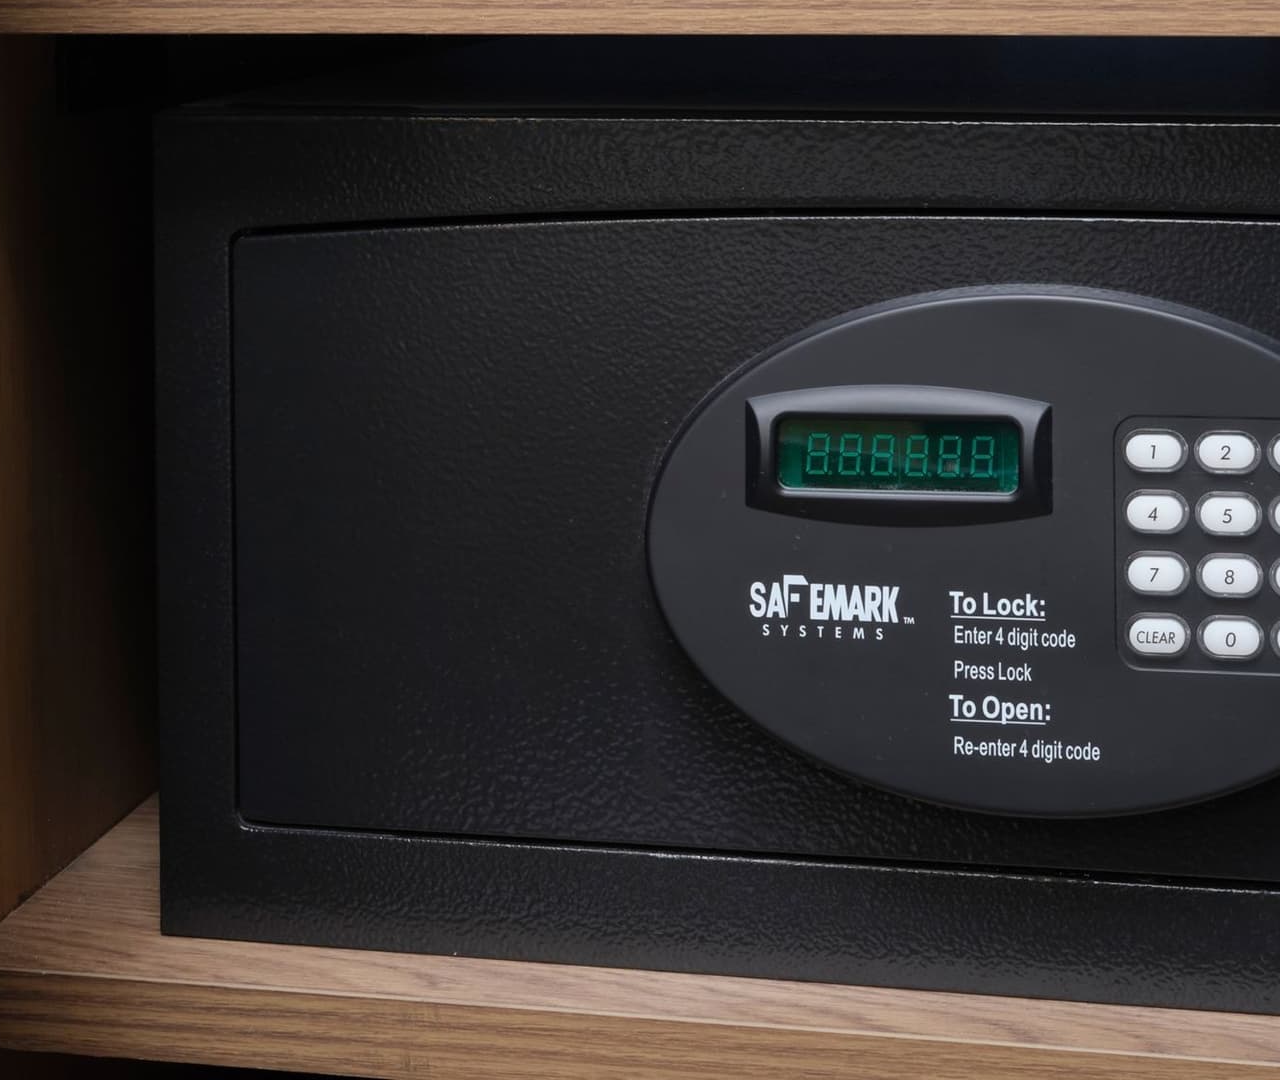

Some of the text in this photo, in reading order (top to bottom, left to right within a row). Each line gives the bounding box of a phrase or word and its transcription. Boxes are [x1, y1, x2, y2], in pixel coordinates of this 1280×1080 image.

[1150, 444, 1157, 460] 1
[1220, 445, 1231, 461] 2
[1147, 506, 1158, 522] 4
[1222, 508, 1233, 524] 5
[1149, 567, 1160, 583] 7
[1224, 569, 1235, 585] 8
[749, 574, 900, 624] SAFEMARK
[949, 590, 1047, 617] To Lock:
[762, 623, 885, 641] SYSTEMS
[953, 625, 1076, 651] Enter 4 digit code
[1136, 630, 1176, 645] CLEAR
[1225, 631, 1237, 648] 0
[953, 660, 1032, 682] Press Lock
[949, 693, 1051, 725] To Open:
[953, 736, 1101, 764] Re-enter 4 digit code
